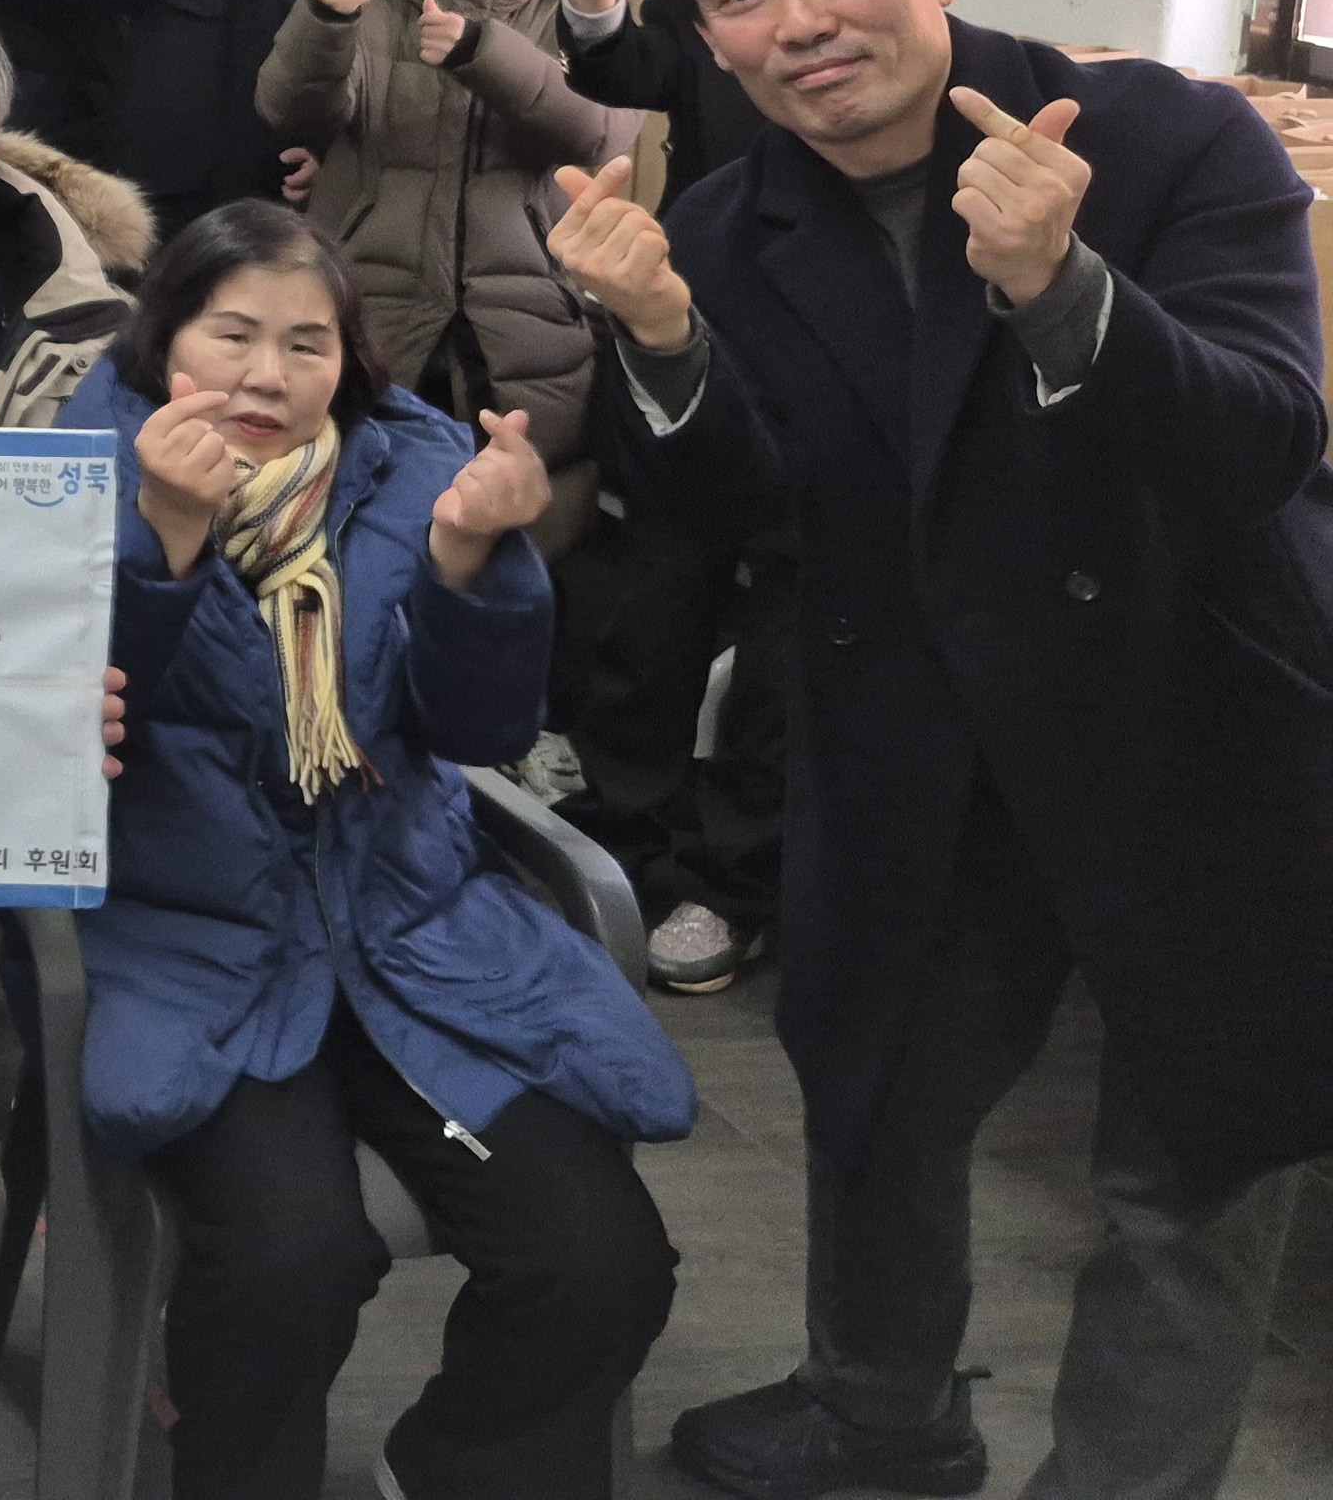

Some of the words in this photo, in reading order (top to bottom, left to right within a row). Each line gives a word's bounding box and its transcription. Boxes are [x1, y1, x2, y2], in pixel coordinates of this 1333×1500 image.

[12, 477, 52, 496] 행복한
[57, 462, 110, 496] 성북
[23, 847, 99, 876] 후원회
